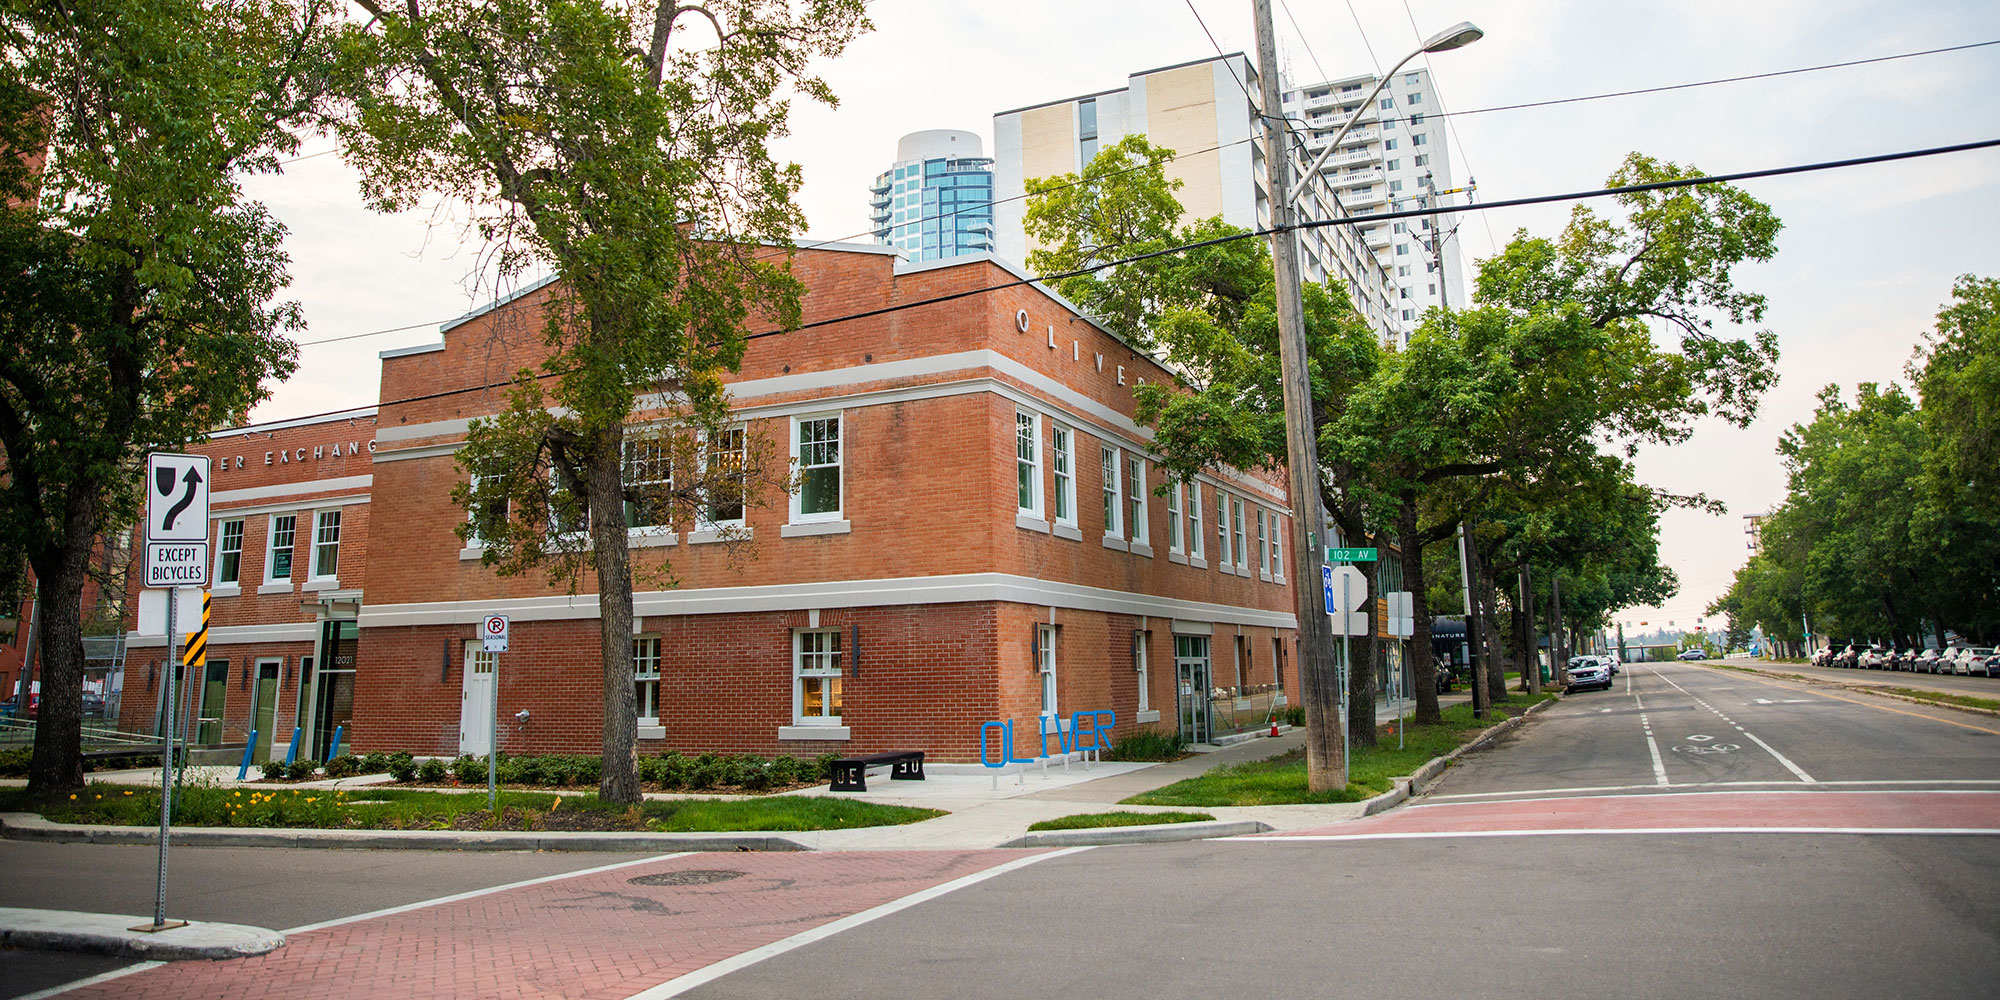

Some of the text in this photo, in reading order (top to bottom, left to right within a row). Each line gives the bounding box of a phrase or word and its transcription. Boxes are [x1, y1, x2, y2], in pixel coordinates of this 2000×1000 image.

[210, 455, 245, 470] ER
[159, 548, 197, 561] EXCEPT
[1333, 550, 1369, 560] 102 AV
[153, 566, 201, 580] BICYCLES
[335, 656, 353, 665] 12021
[981, 709, 1116, 768] OLIVER
